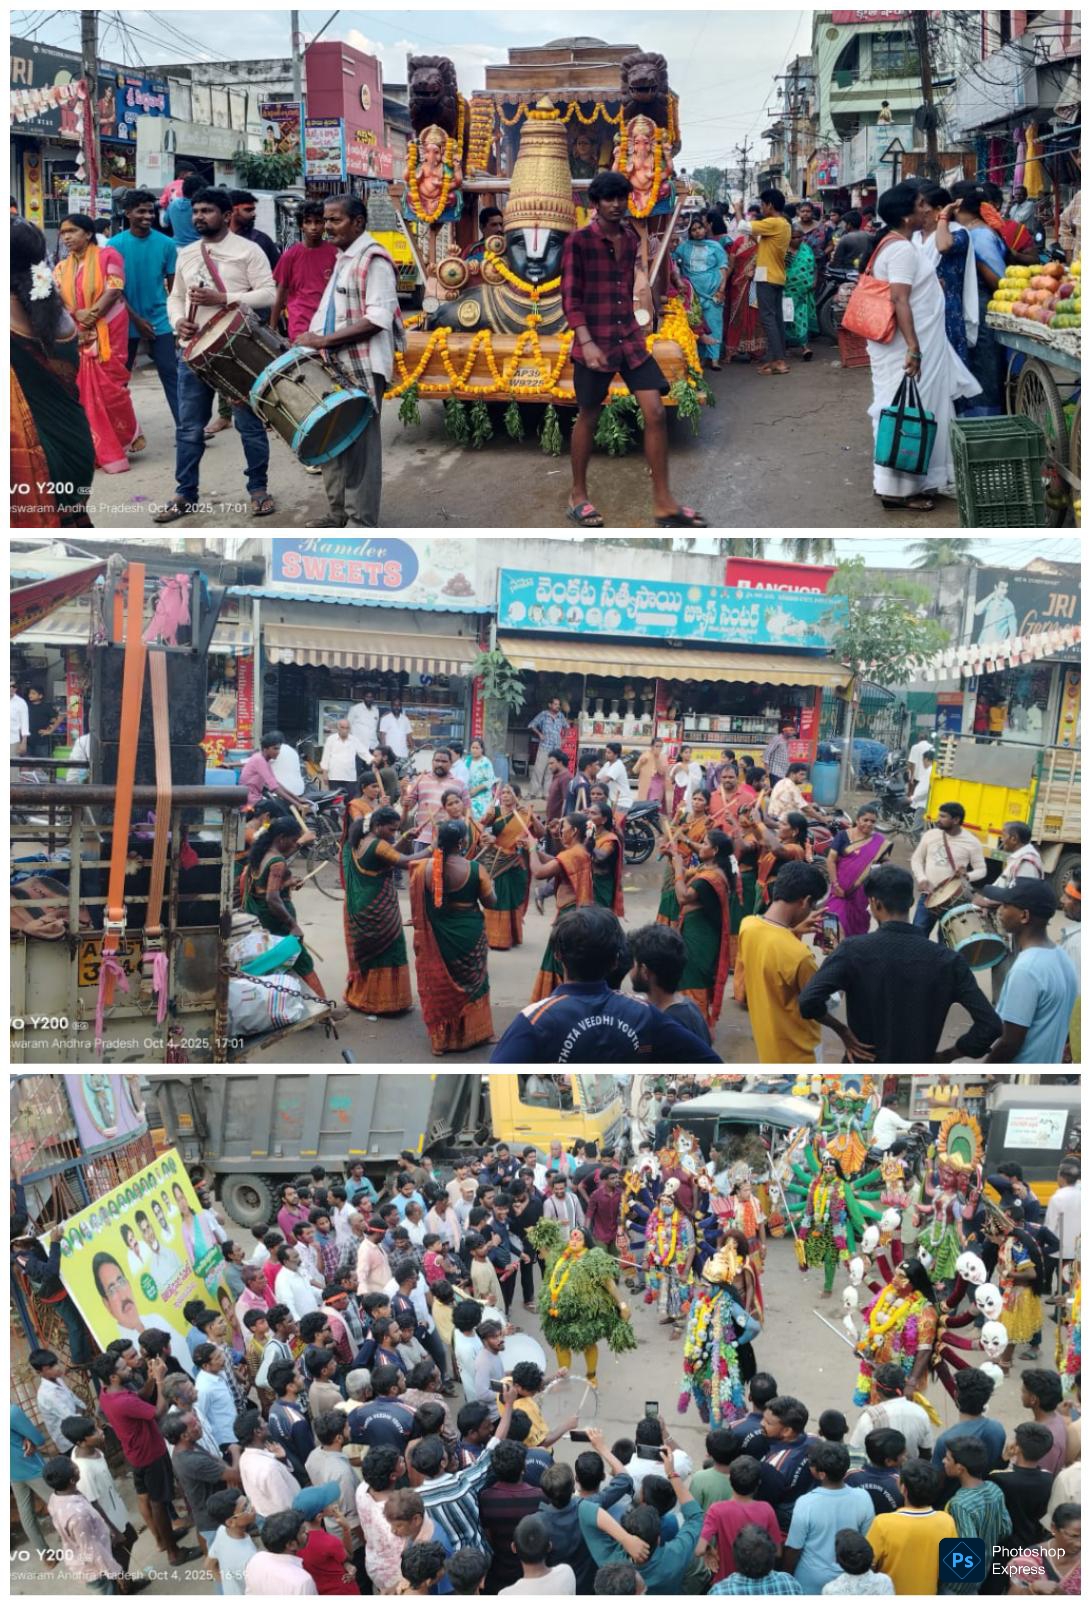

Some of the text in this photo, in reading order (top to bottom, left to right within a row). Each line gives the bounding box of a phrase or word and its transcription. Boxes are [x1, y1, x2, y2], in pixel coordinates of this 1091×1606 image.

[282, 551, 403, 588] SWEETS
[1041, 592, 1077, 619] JRI
[558, 1015, 641, 1063] THOTA VEEDHI YOUTH
